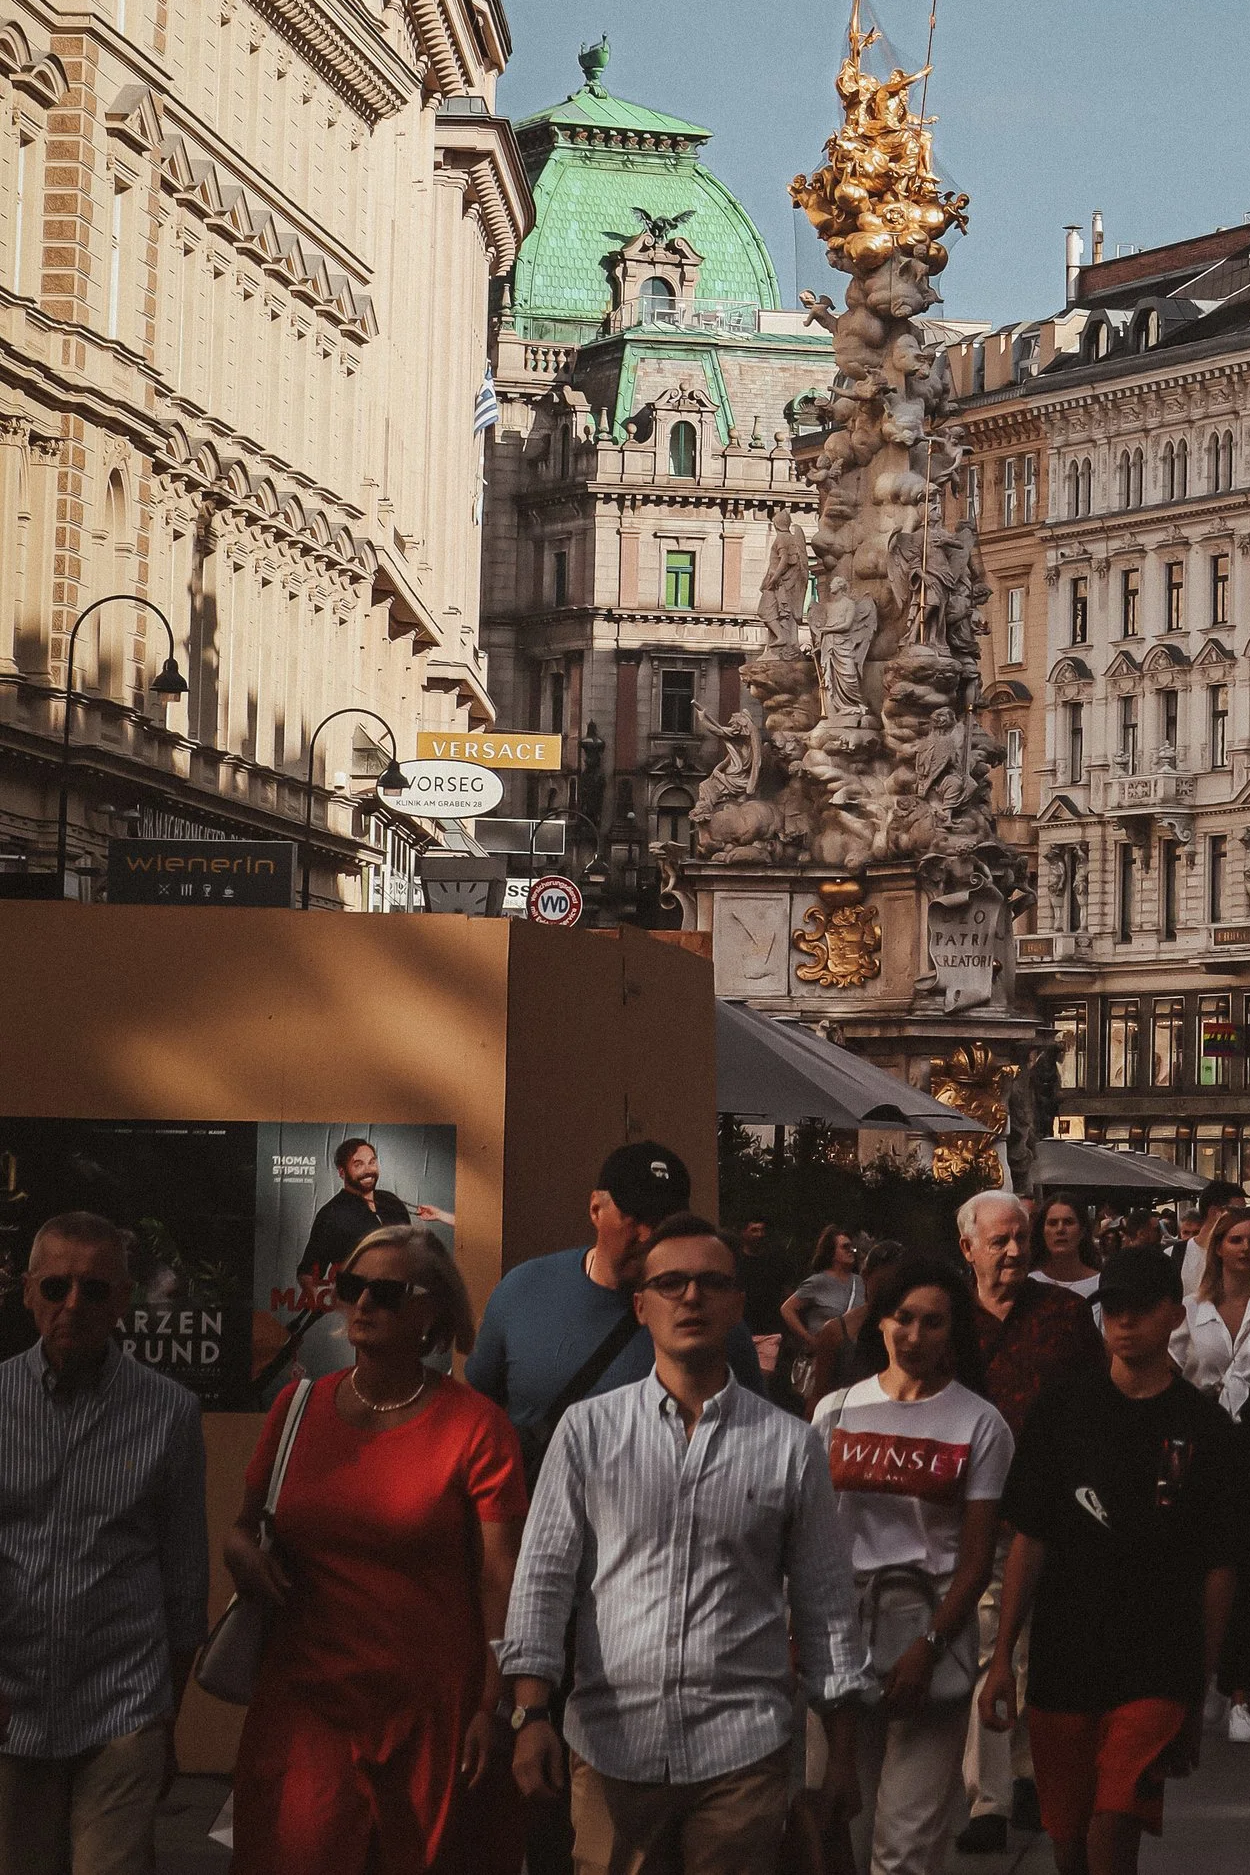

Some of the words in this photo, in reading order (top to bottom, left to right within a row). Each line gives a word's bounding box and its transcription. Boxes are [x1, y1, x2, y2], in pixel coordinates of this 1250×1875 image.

[432, 740, 546, 760] VERSACE
[395, 799, 421, 807] KLINIK
[437, 800, 471, 808] GRABEN
[541, 895, 569, 914] VVD
[935, 931, 989, 947] PATRI
[934, 954, 992, 968] CREATORI
[272, 1155, 317, 1166] THOMAS
[272, 1166, 316, 1176] STIPSITS
